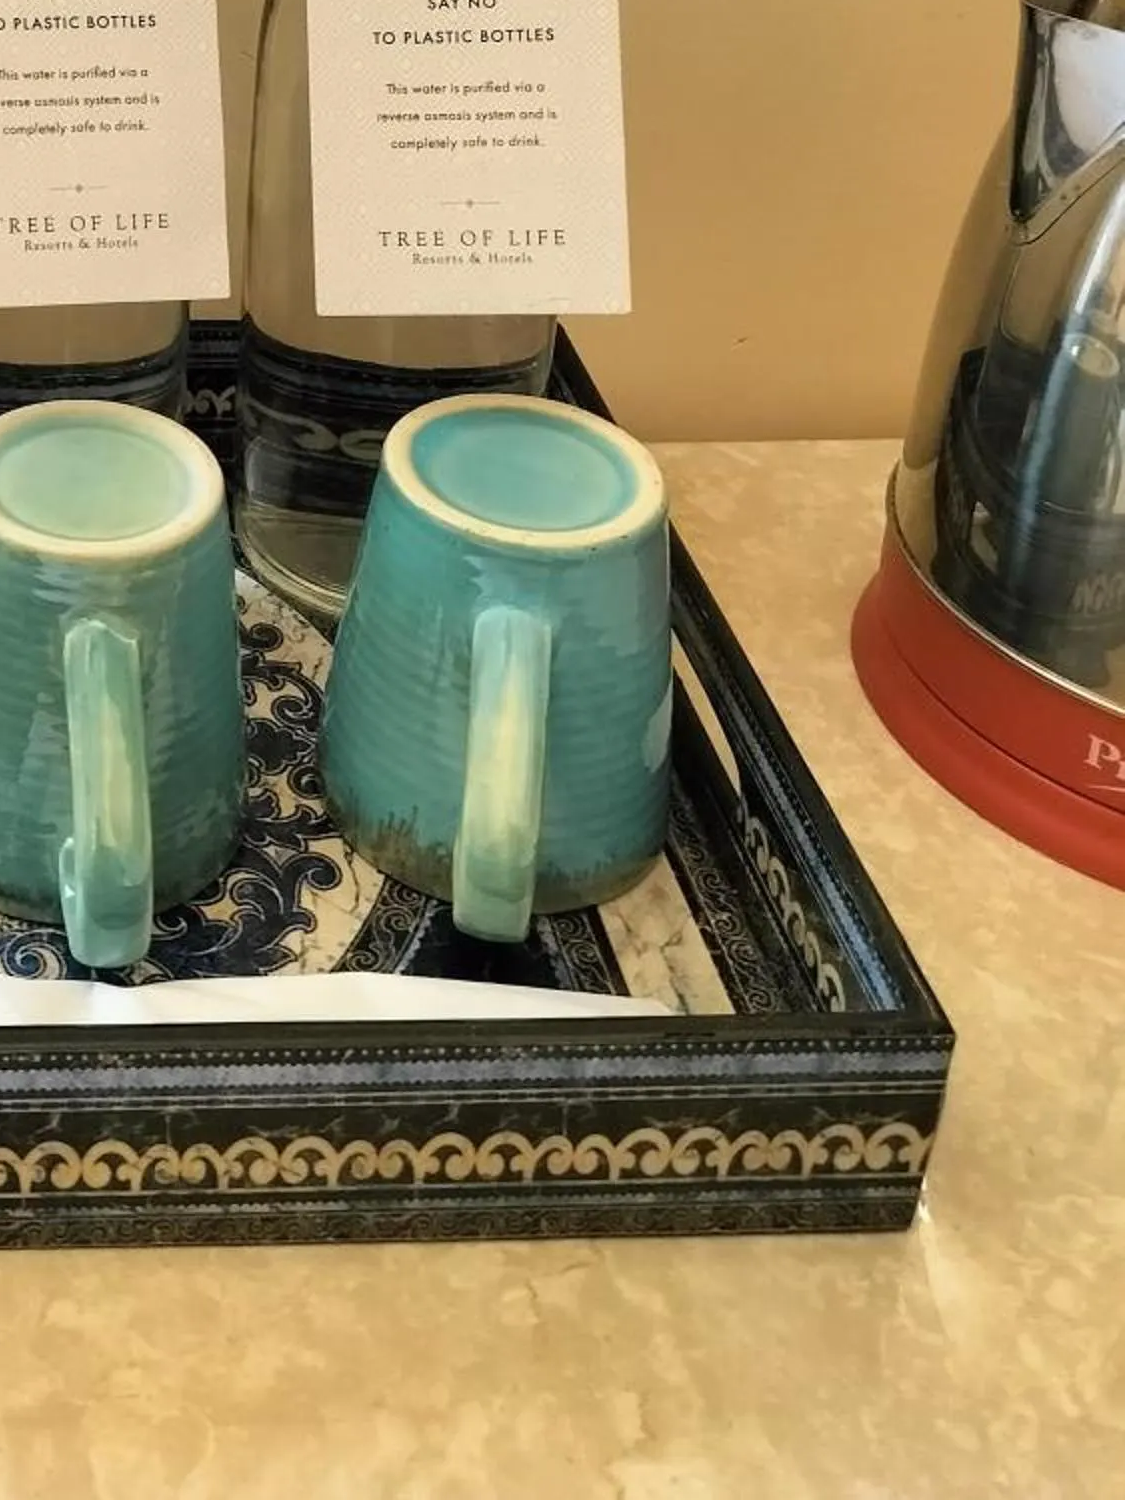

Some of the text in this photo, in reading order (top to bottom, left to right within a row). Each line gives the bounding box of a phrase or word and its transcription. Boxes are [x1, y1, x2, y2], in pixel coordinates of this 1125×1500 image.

[13, 15, 80, 31] PLASTIC
[86, 14, 157, 29] BOTTLES
[373, 27, 555, 45] TO PLASTIC BOTTLES
[22, 69, 55, 80] water
[58, 68, 69, 80] is
[71, 65, 116, 81] purified
[118, 67, 137, 77] via
[386, 83, 408, 95] This
[411, 83, 447, 94] water
[450, 83, 460, 94] is
[462, 80, 510, 96] purified
[514, 83, 532, 93] via
[34, 96, 80, 108] osmosis
[83, 95, 123, 108] system
[124, 93, 148, 105] and
[150, 93, 160, 105] is
[377, 108, 557, 123] reverse osmosis system and is
[2, 122, 67, 136] completely
[70, 120, 96, 133] safe
[99, 120, 112, 133] to
[390, 136, 457, 151] completely
[462, 134, 488, 147] safe
[492, 135, 505, 146] to
[70, 215, 103, 232] OF
[115, 213, 171, 230] LIFE
[24, 236, 139, 251] Resorts & Hotels
[379, 229, 567, 247] TREE OF LIFE
[412, 251, 533, 265] Resorts & Hotels
